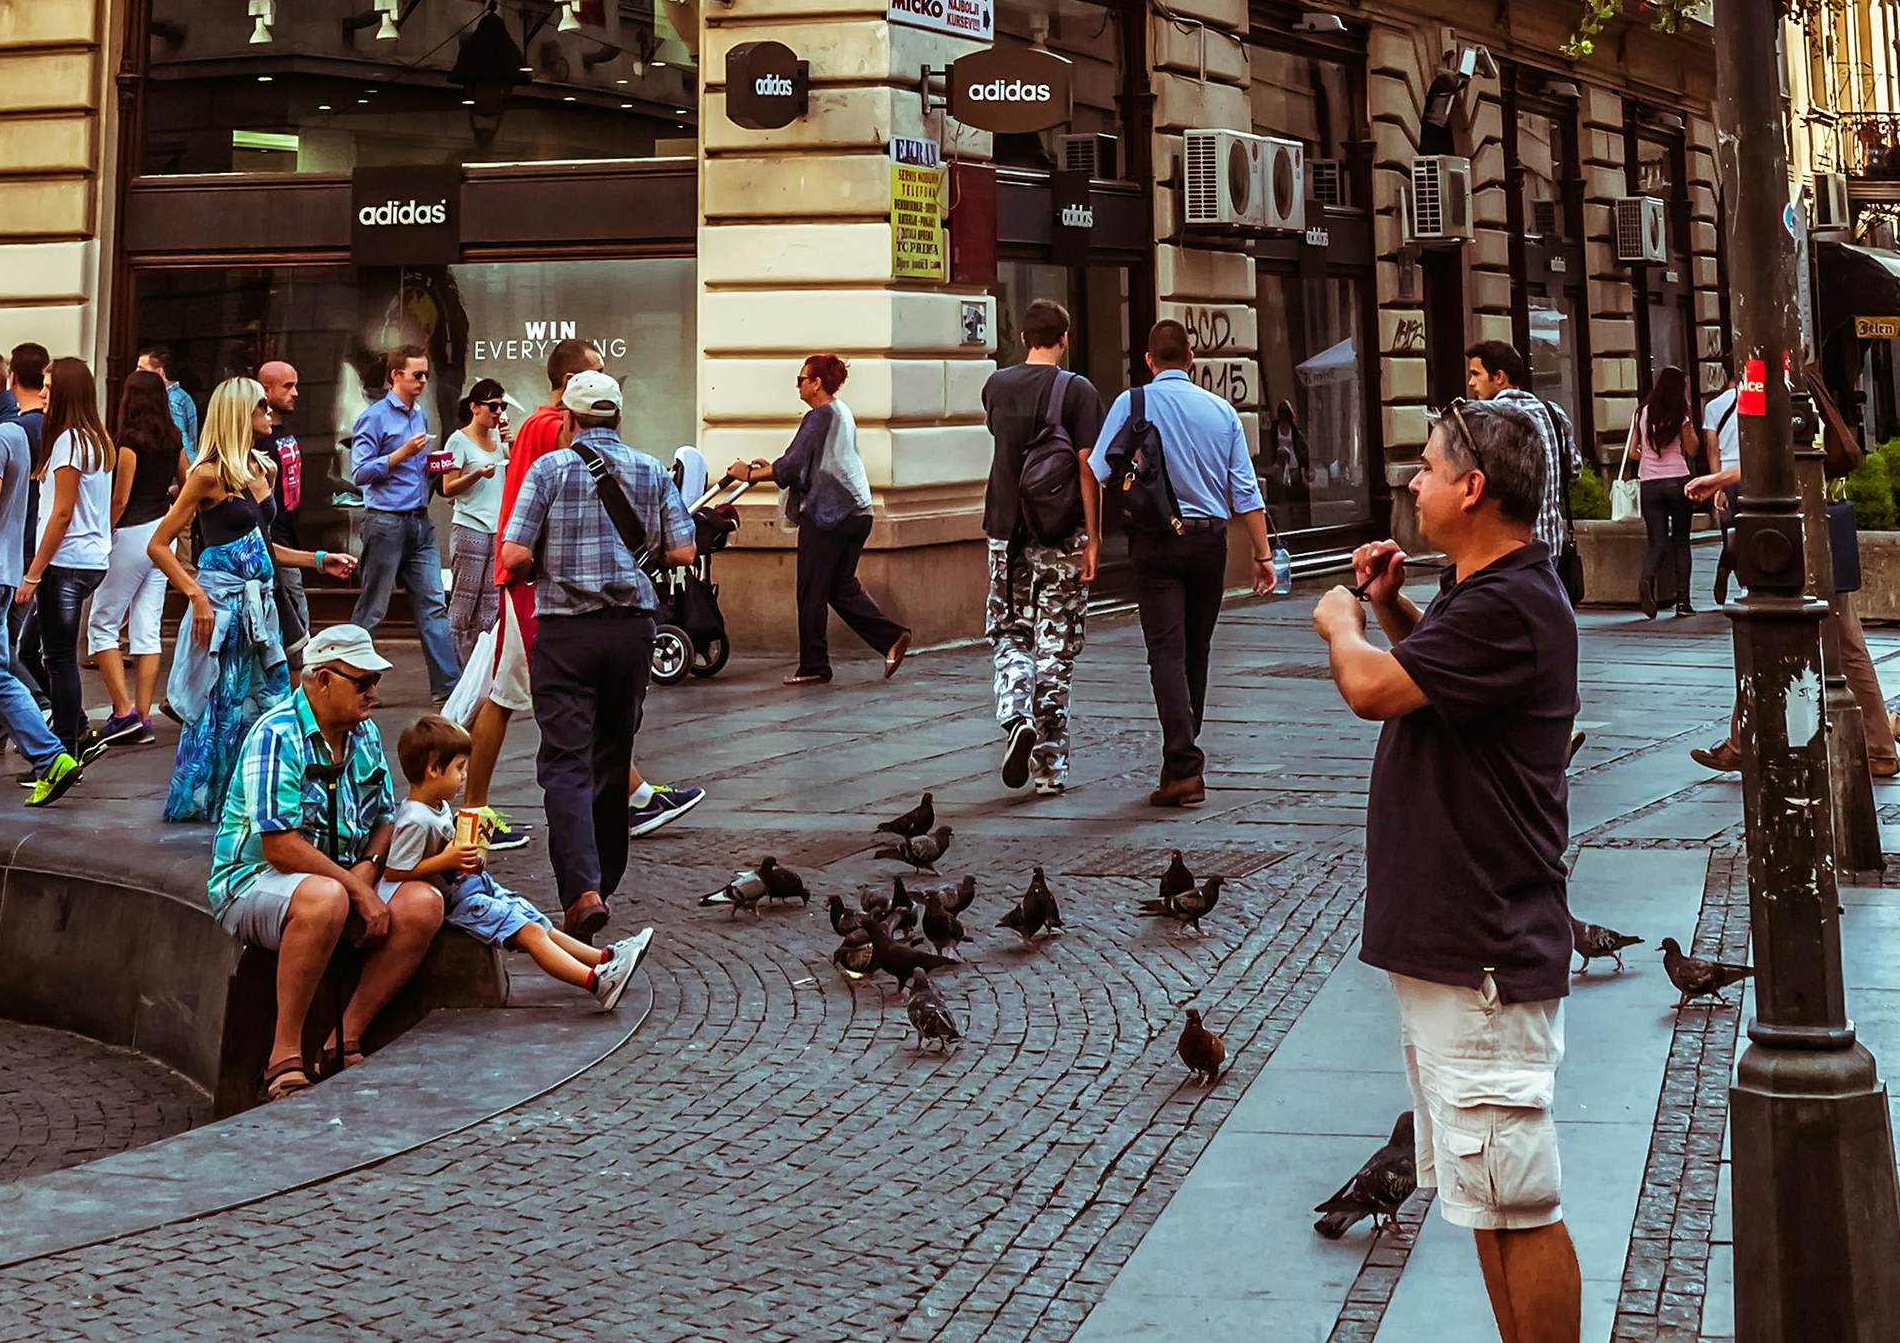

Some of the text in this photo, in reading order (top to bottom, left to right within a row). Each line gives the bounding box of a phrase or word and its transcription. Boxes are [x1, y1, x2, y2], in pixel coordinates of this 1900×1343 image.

[755, 73, 793, 96] adidas
[968, 79, 1051, 102] adidas
[358, 198, 447, 225] adidas
[525, 320, 577, 340] WIN
[1857, 320, 1893, 335] Jelen
[474, 338, 626, 360] EVERYNG
